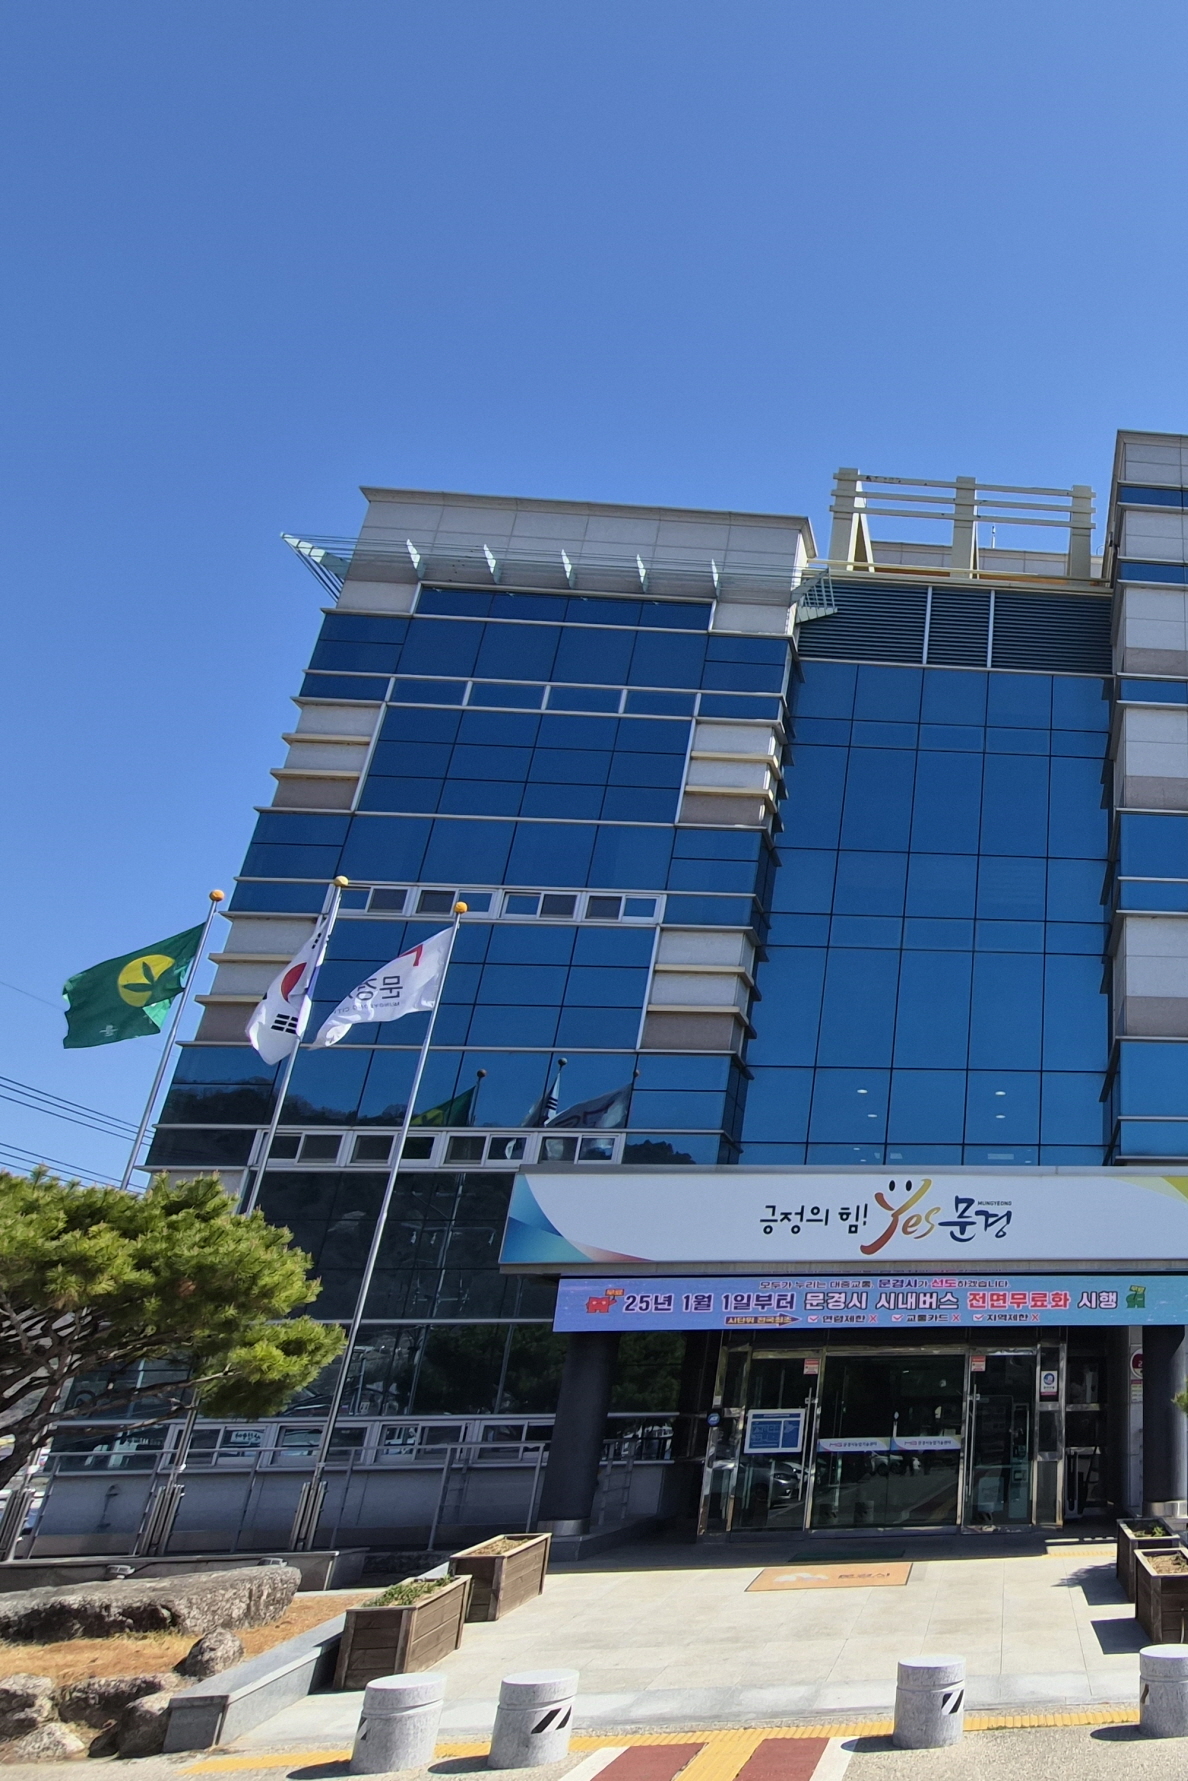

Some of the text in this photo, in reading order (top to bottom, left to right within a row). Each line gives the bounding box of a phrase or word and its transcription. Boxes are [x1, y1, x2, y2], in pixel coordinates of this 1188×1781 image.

[759, 1178, 1012, 1255] 긍정의 힘! Yes 문경
[759, 1281, 792, 1289] 모두가
[795, 1281, 827, 1289] 누리는
[878, 1279, 928, 1288] 문경시가
[931, 1278, 1010, 1288] 선도하겠습니다.
[623, 1291, 1118, 1312] 25년 1월 1일부터 문경시 시내버스 전면무료화 시행
[906, 1314, 949, 1322] 교통카드
[987, 1313, 1029, 1322] 지역제한
